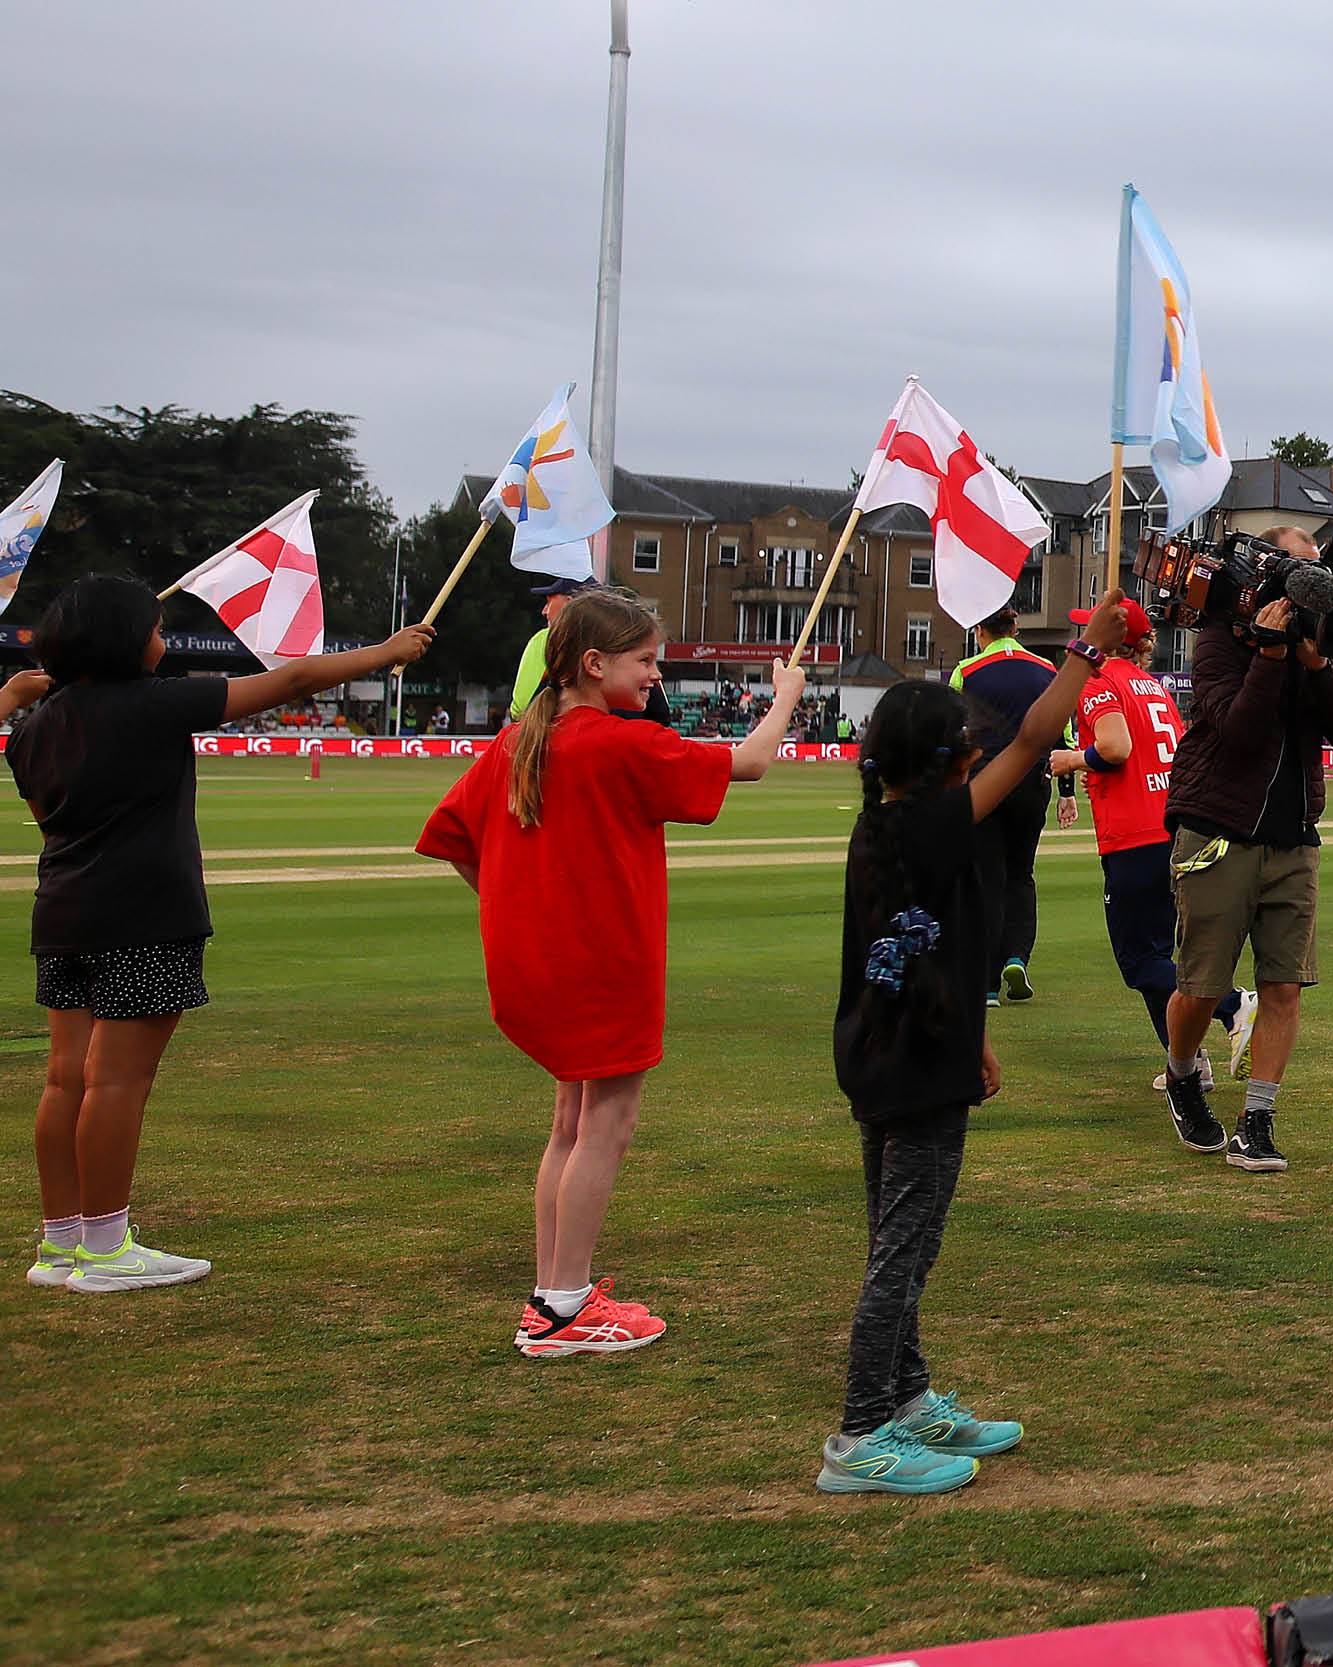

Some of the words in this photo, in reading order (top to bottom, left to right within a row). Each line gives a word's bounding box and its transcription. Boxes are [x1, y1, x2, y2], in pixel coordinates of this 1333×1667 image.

[187, 636, 237, 652] Future
[1083, 690, 1118, 715] cinch
[1147, 702, 1178, 764] 5
[194, 737, 219, 753] IG
[248, 737, 272, 753] IG
[351, 739, 375, 754] IG
[401, 739, 424, 754] IG
[450, 739, 473, 755] IG
[778, 743, 797, 759] IG
[821, 743, 841, 759] IG
